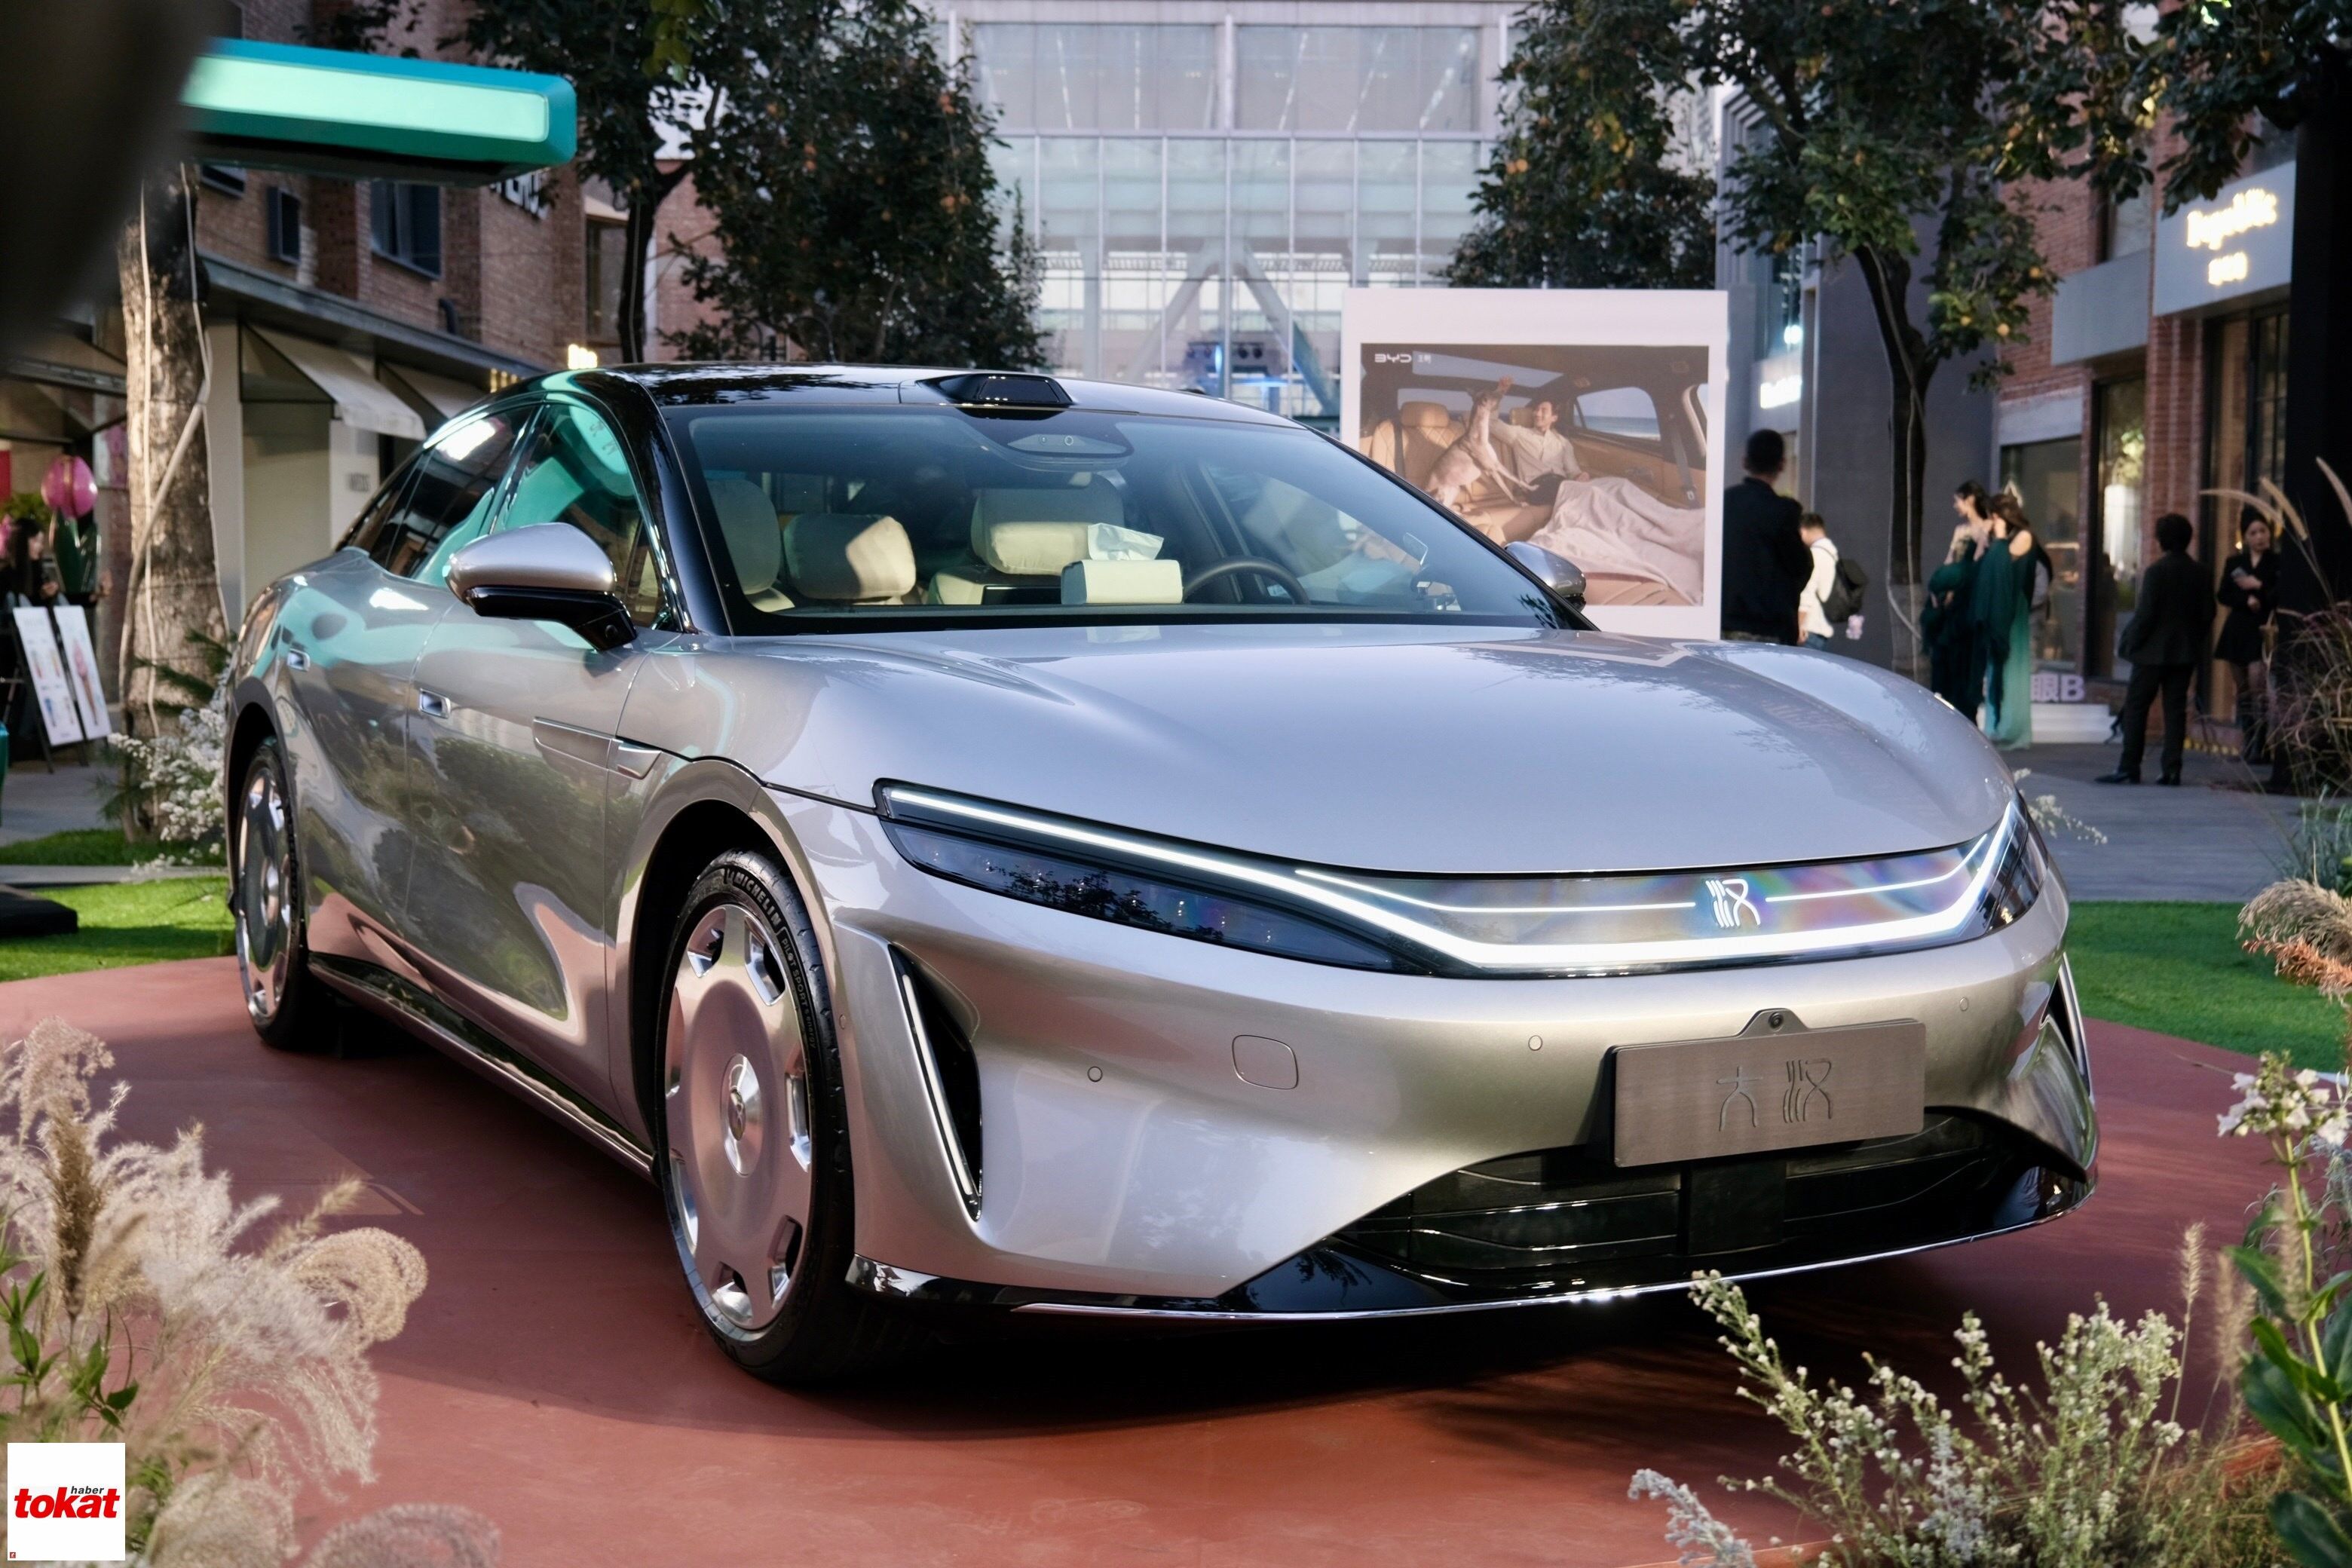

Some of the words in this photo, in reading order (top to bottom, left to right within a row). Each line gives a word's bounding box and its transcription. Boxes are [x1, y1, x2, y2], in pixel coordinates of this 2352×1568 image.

[1374, 354, 1412, 363] BYD
[733, 871, 782, 926] MICHELIN
[781, 938, 797, 966] PILOT
[792, 969, 809, 1006] SPORT
